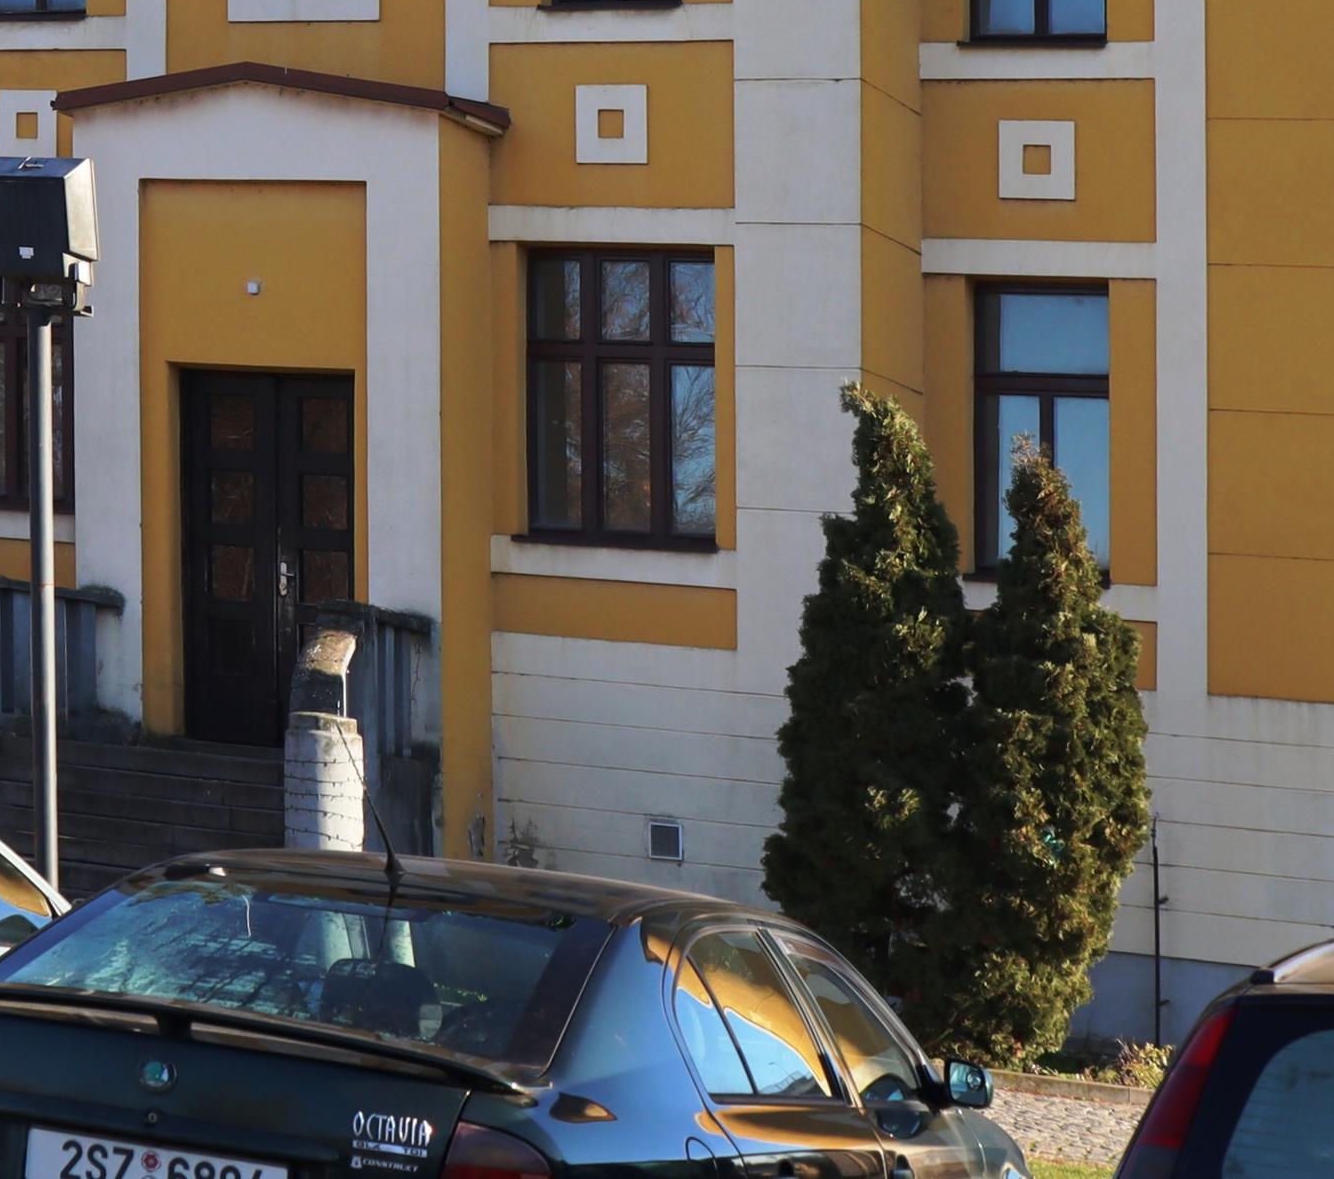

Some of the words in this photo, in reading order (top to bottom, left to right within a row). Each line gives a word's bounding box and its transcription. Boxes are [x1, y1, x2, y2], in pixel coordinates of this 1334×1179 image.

[353, 1110, 433, 1148] OCTAVIA
[60, 1139, 135, 1179] 2S7
[362, 1157, 419, 1173] CONSTRUCT
